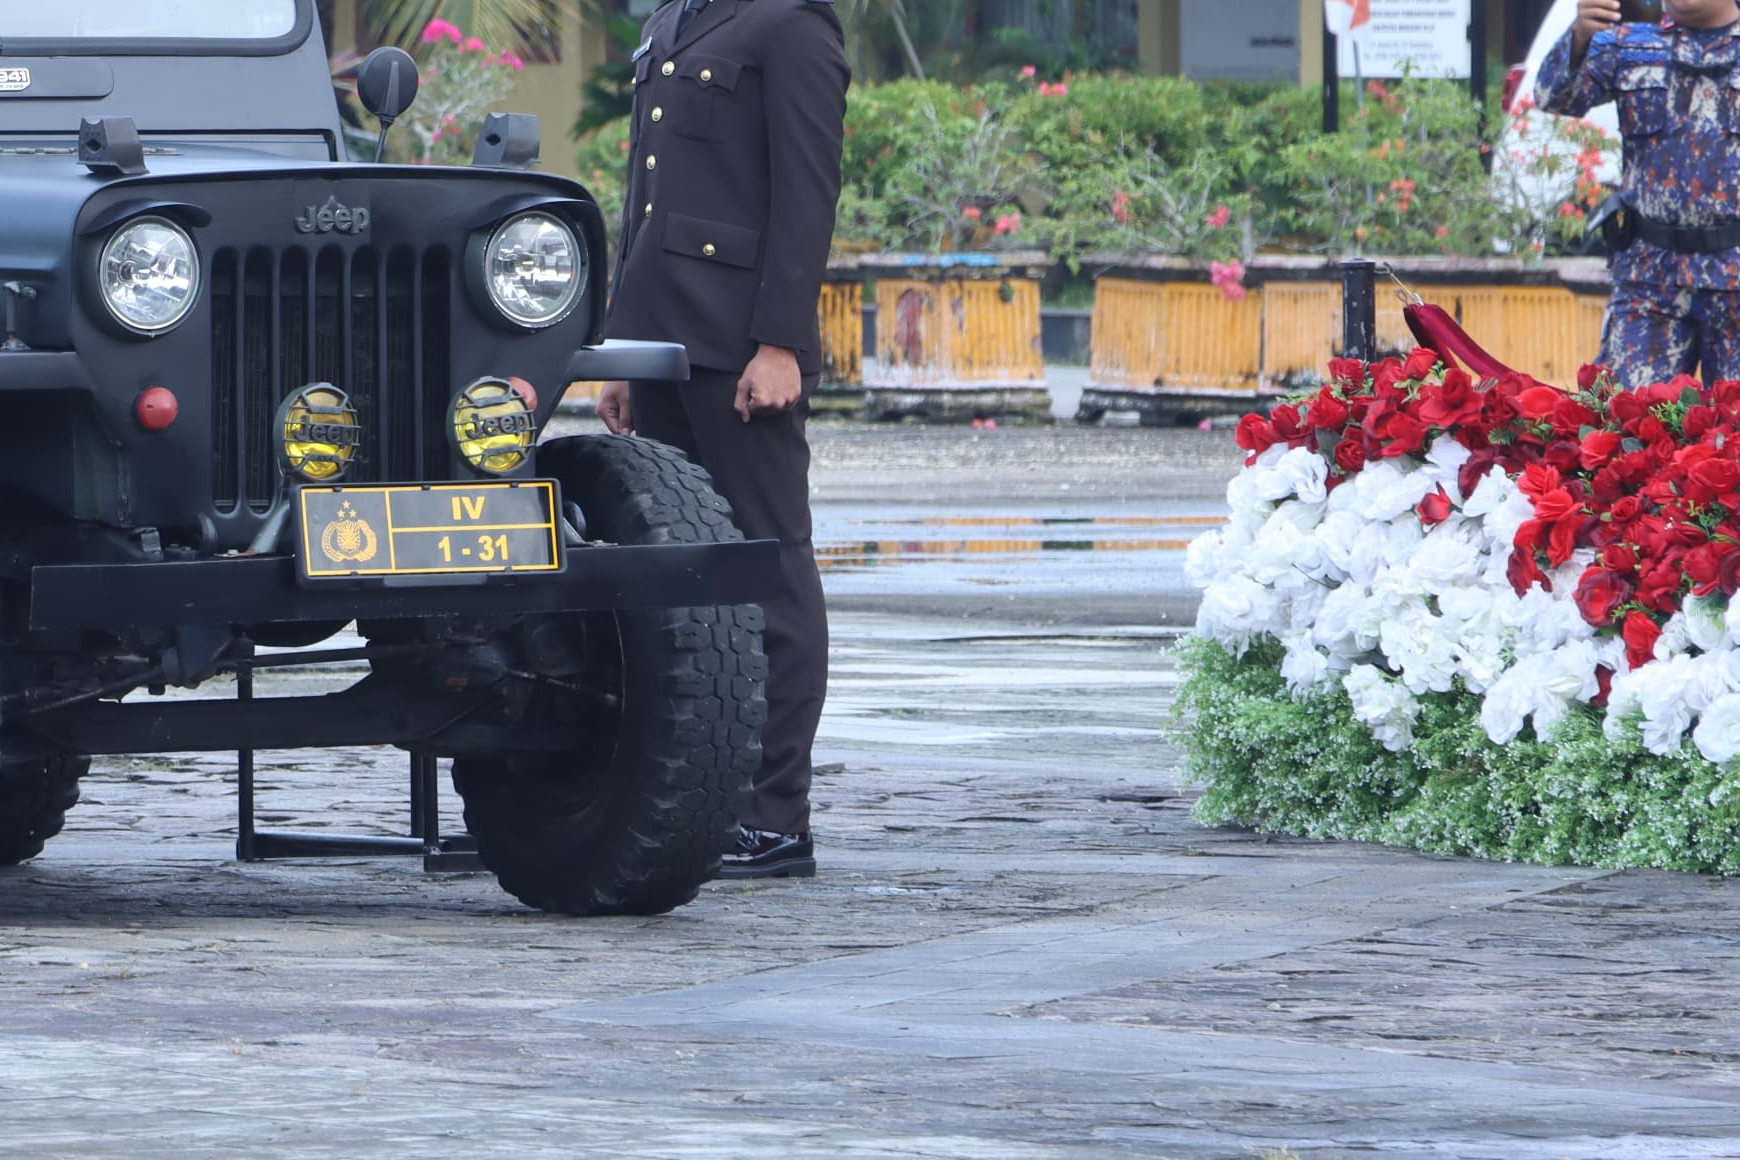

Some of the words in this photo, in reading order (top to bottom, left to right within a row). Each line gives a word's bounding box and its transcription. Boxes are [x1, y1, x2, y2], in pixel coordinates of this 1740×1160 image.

[293, 206, 370, 234] Jeep
[292, 414, 359, 444] Jeep
[465, 412, 529, 440] Jeep
[452, 496, 485, 521] IV
[438, 536, 452, 562] 1
[478, 534, 509, 561] 31
